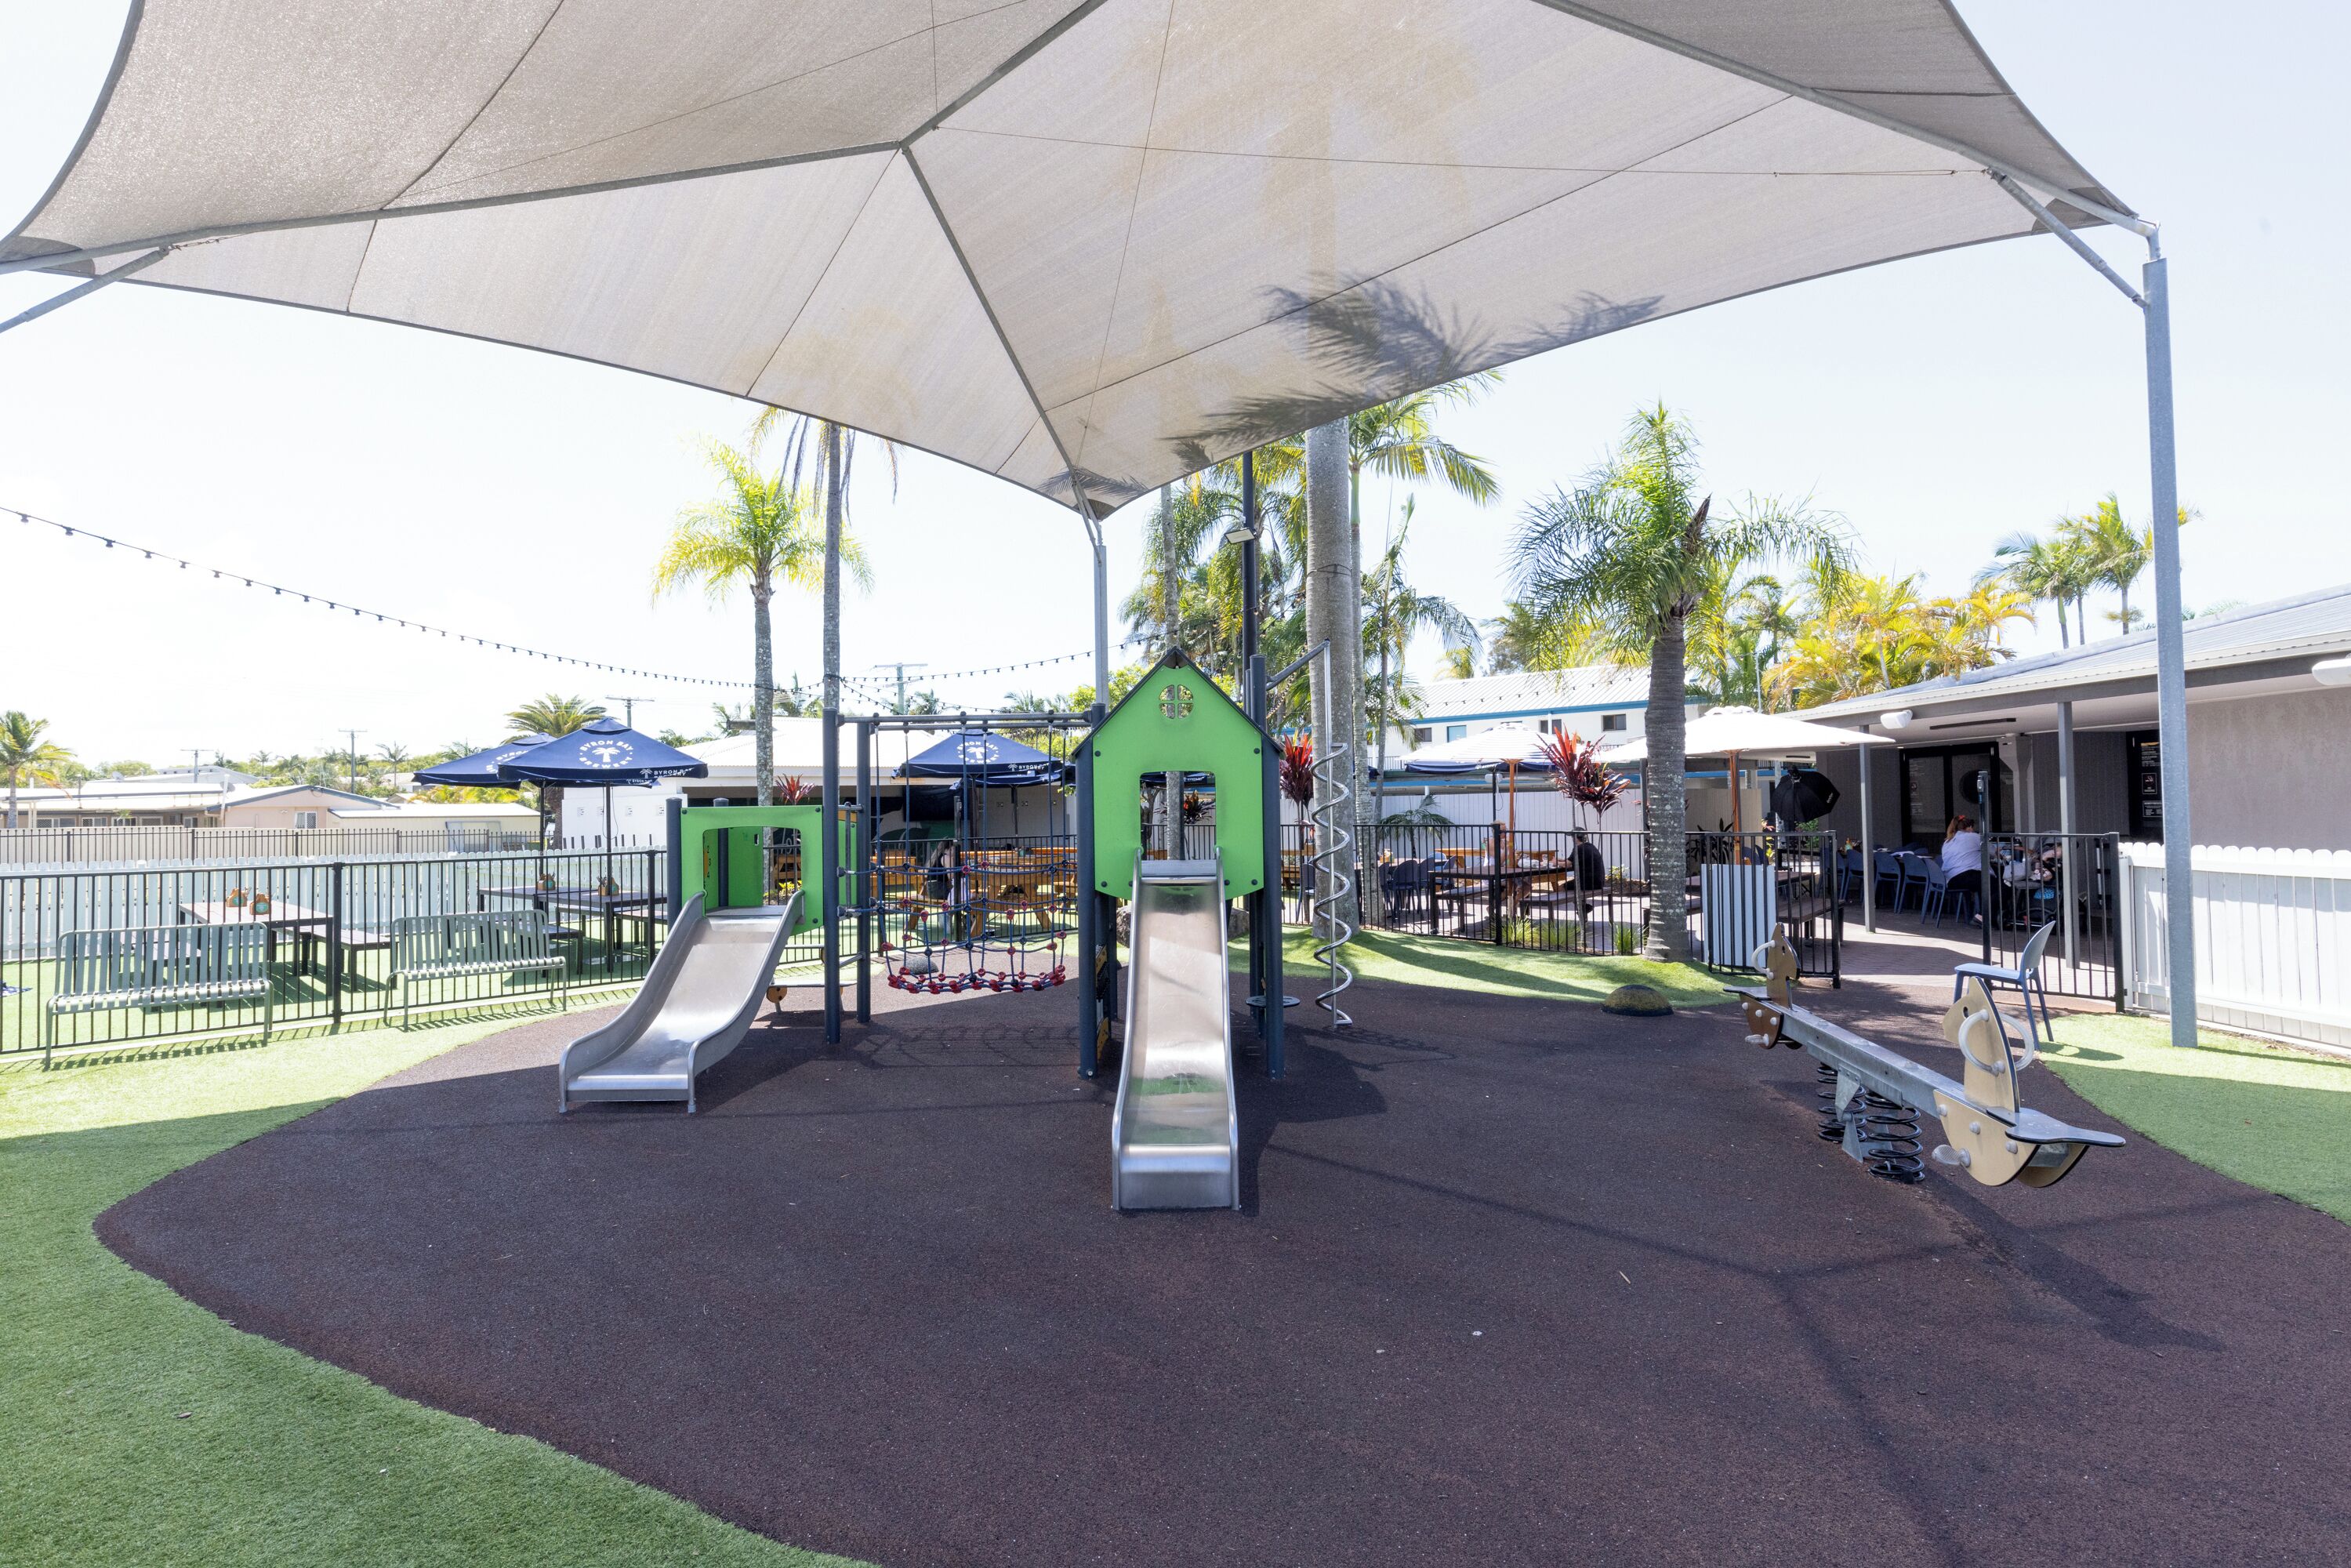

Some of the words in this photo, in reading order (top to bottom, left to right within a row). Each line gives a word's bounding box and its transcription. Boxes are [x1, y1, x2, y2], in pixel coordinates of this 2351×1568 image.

[579, 740, 614, 752] BYRON
[616, 741, 634, 751] BAY
[579, 756, 633, 769] BREWERY
